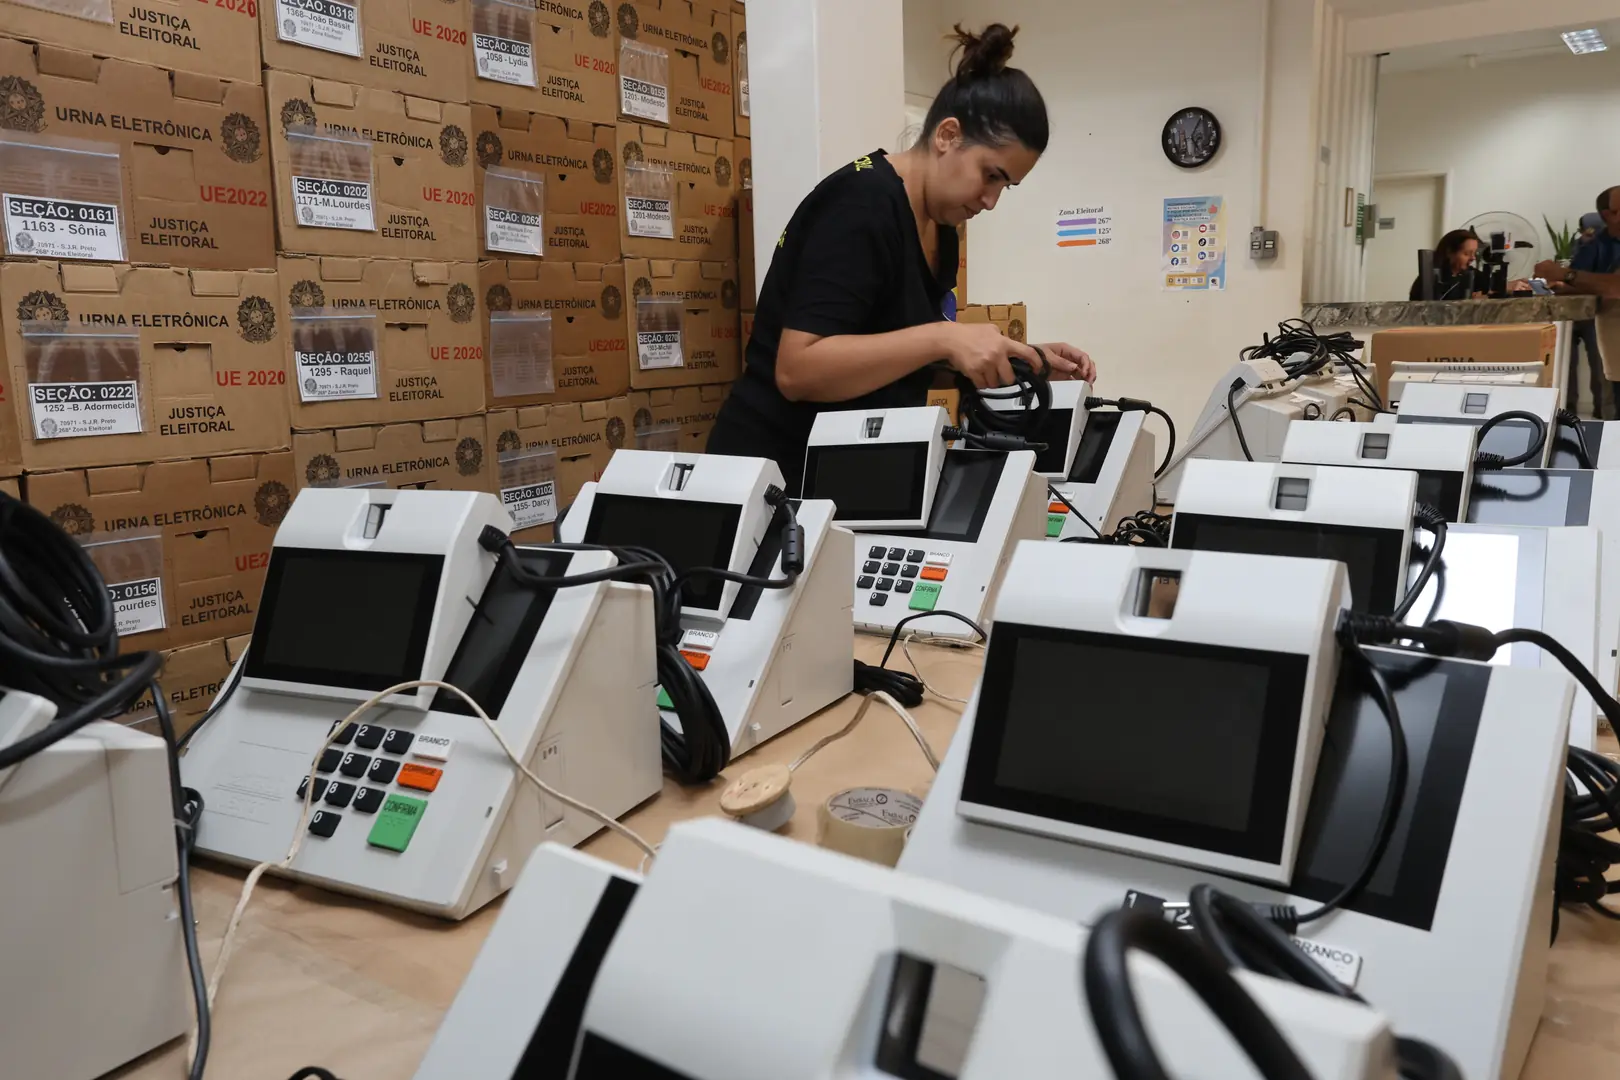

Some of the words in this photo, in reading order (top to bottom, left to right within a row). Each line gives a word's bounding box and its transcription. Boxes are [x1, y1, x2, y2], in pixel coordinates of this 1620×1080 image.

[129, 7, 191, 31] JUSTIÇA
[330, 5, 354, 20] 0318
[328, 18, 350, 31] Bassit
[413, 18, 432, 36] UE
[436, 25, 466, 46] 2020
[120, 22, 200, 50] ELEITORAL
[642, 23, 663, 36] URNA
[665, 30, 708, 50] ELETRÔNICA
[376, 43, 420, 62] JUSTIÇA
[476, 37, 510, 52] SEÇÃO:
[512, 44, 530, 56] 0033
[370, 56, 427, 76] ELEITORAL
[486, 52, 502, 62] 1058
[508, 56, 528, 67] Lydia
[574, 54, 589, 68] UE
[593, 58, 616, 75] 2020
[546, 75, 580, 90] JUSTIÇA
[542, 87, 585, 103] ELEITORAL
[680, 97, 705, 110] JUSTIÇA
[676, 107, 710, 121] ELEITORAL
[56, 106, 107, 128] URNA
[112, 115, 213, 142] ELETRÔNICA
[362, 129, 434, 150] ELETRÔNICA
[508, 150, 534, 163] URNA
[536, 154, 588, 170] ELETRÔNICA
[200, 185, 268, 207] UE2022
[298, 181, 340, 196] SEÇÃO:
[344, 186, 366, 197] 0202
[423, 187, 442, 201] UE
[446, 190, 475, 206] 2020
[297, 196, 370, 210] 1171-M.Lourdes
[580, 201, 616, 216] UE2022
[10, 200, 74, 218] SEÇÃO:
[80, 208, 114, 222] 0161
[1058, 208, 1075, 216] Zona
[1076, 206, 1104, 215] Eleitoral
[150, 218, 208, 234] JUSTIÇA
[388, 215, 430, 229] JUSTIÇA
[522, 214, 539, 226] 0262
[22, 220, 56, 232] 1163
[68, 224, 106, 237] Sônia
[382, 228, 437, 242] ELEITORAL
[554, 226, 586, 238] JUSTIÇA
[683, 224, 708, 235] JUSTIÇA
[141, 233, 219, 250] ELEITORAL
[549, 238, 590, 249] ELEITORAL
[680, 236, 712, 246] ELEITORAL
[369, 297, 441, 310] ELETRÔNICA
[517, 300, 542, 310] URNA
[544, 298, 596, 310] ELETRÔNICA
[80, 314, 127, 327] URNA
[132, 312, 229, 328] ELETRÔNICA
[302, 351, 344, 366] SEÇÃO:
[348, 352, 370, 363] 0255
[430, 348, 448, 360] UE
[454, 347, 482, 360] 2020
[216, 371, 242, 386] UE
[248, 370, 286, 386] 2020
[310, 368, 332, 376] 1295
[340, 366, 371, 377] Raquel
[562, 366, 594, 376] JUSTIÇA
[396, 376, 437, 388] JUSTIÇA
[558, 377, 599, 388] ELEITORAL
[36, 386, 96, 402] SEÇÃO:
[100, 386, 133, 399] 0222
[390, 390, 444, 402] ELEITORAL
[44, 404, 65, 412] 1252
[84, 402, 135, 411] Adormecida
[168, 406, 226, 420] JUSTIÇA
[160, 421, 235, 436] ELEITORAL
[552, 432, 602, 448] ELETRÔNICA
[346, 464, 380, 479] URNA
[382, 456, 450, 474] ELETRÔNICA
[504, 488, 534, 502] SEÇÃO:
[536, 486, 552, 496] 0102
[532, 499, 550, 508] Darcy
[105, 516, 150, 532] URNA
[154, 504, 246, 526] ELETRÔNICA
[125, 583, 156, 598] 0156
[114, 600, 156, 613] ourdes
[190, 590, 244, 610] JUSTIÇA
[181, 604, 252, 627] ELEITORAL
[688, 630, 714, 638] BRANCO
[358, 726, 368, 736] 2
[386, 730, 396, 742] 3
[418, 735, 450, 746] BRANCO
[344, 754, 354, 764] 5
[372, 760, 382, 770] 6
[329, 783, 338, 794] 8
[357, 788, 366, 800] 9
[384, 801, 417, 816] CONFIRMA
[313, 812, 322, 823] 0
[1128, 893, 1138, 909] 1
